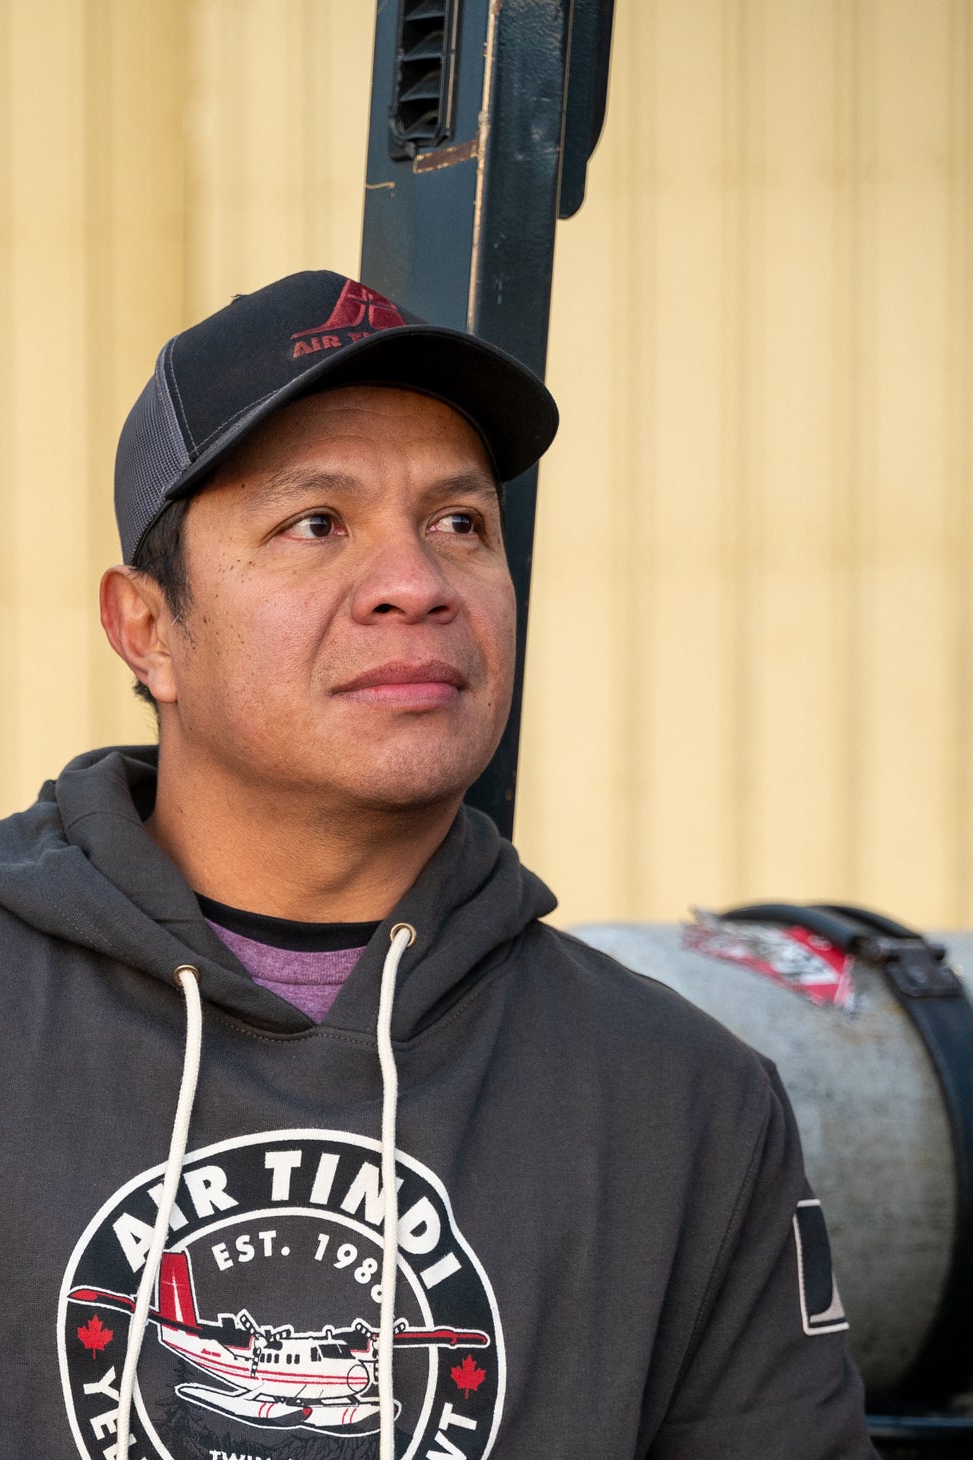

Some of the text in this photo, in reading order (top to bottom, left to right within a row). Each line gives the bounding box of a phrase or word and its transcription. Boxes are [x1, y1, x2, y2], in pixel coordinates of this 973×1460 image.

[293, 333, 342, 358] AIR
[112, 1150, 462, 1290] AIR TINDI
[211, 1230, 290, 1271] EST.
